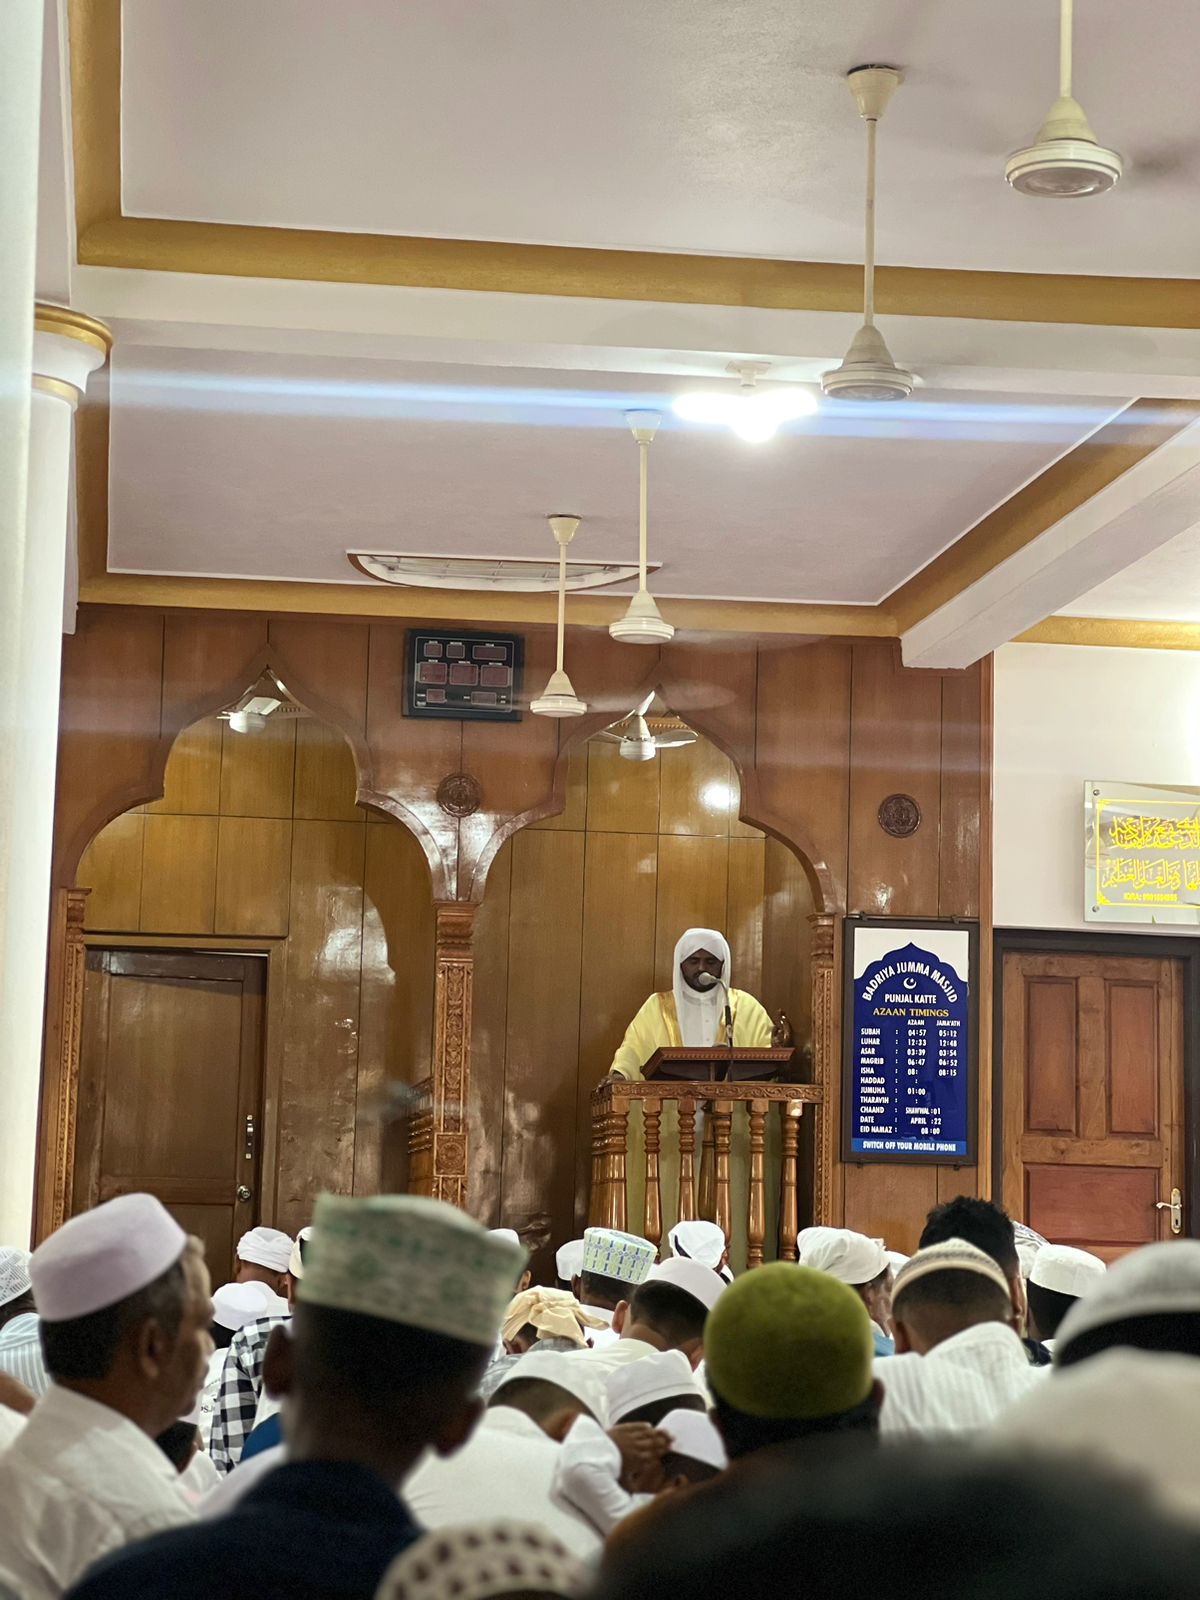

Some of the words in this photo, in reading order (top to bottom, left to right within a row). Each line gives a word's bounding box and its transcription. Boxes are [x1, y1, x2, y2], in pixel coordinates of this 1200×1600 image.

[862, 965, 895, 1001] BADRIYA
[897, 961, 930, 976] JUMMA
[930, 969, 958, 1003] MASJID
[885, 994, 913, 1003] PUNJAL
[915, 995, 936, 1003] KATTE
[873, 1007, 906, 1016] AZAAN
[910, 1008, 949, 1018] TIMINGS
[908, 1018, 925, 1026] AZAAN
[860, 1027, 881, 1036] SUBAH
[908, 1028, 927, 1037] 04:57
[939, 1029, 958, 1038] 05:12
[909, 1038, 927, 1047] 12:33
[860, 1047, 876, 1055] ASAR
[907, 1048, 926, 1056] 03:39
[939, 1049, 957, 1057] 03:54
[860, 1057, 885, 1065] MAGRIB
[908, 1058, 926, 1066] 06:47
[939, 1058, 958, 1067] 06:52
[860, 1066, 875, 1075] ISHA
[939, 1068, 957, 1077] 08:15
[908, 1087, 926, 1096] 01:00
[859, 1105, 885, 1114] CHAAND
[859, 1115, 875, 1124] DATE
[911, 1117, 927, 1125] APRIL
[871, 1125, 893, 1134] NAMAZ
[863, 1140, 884, 1150] SWITCH
[897, 1141, 913, 1150] YOUR
[914, 1142, 936, 1151] MOBILE
[936, 1142, 956, 1152] PHONE
